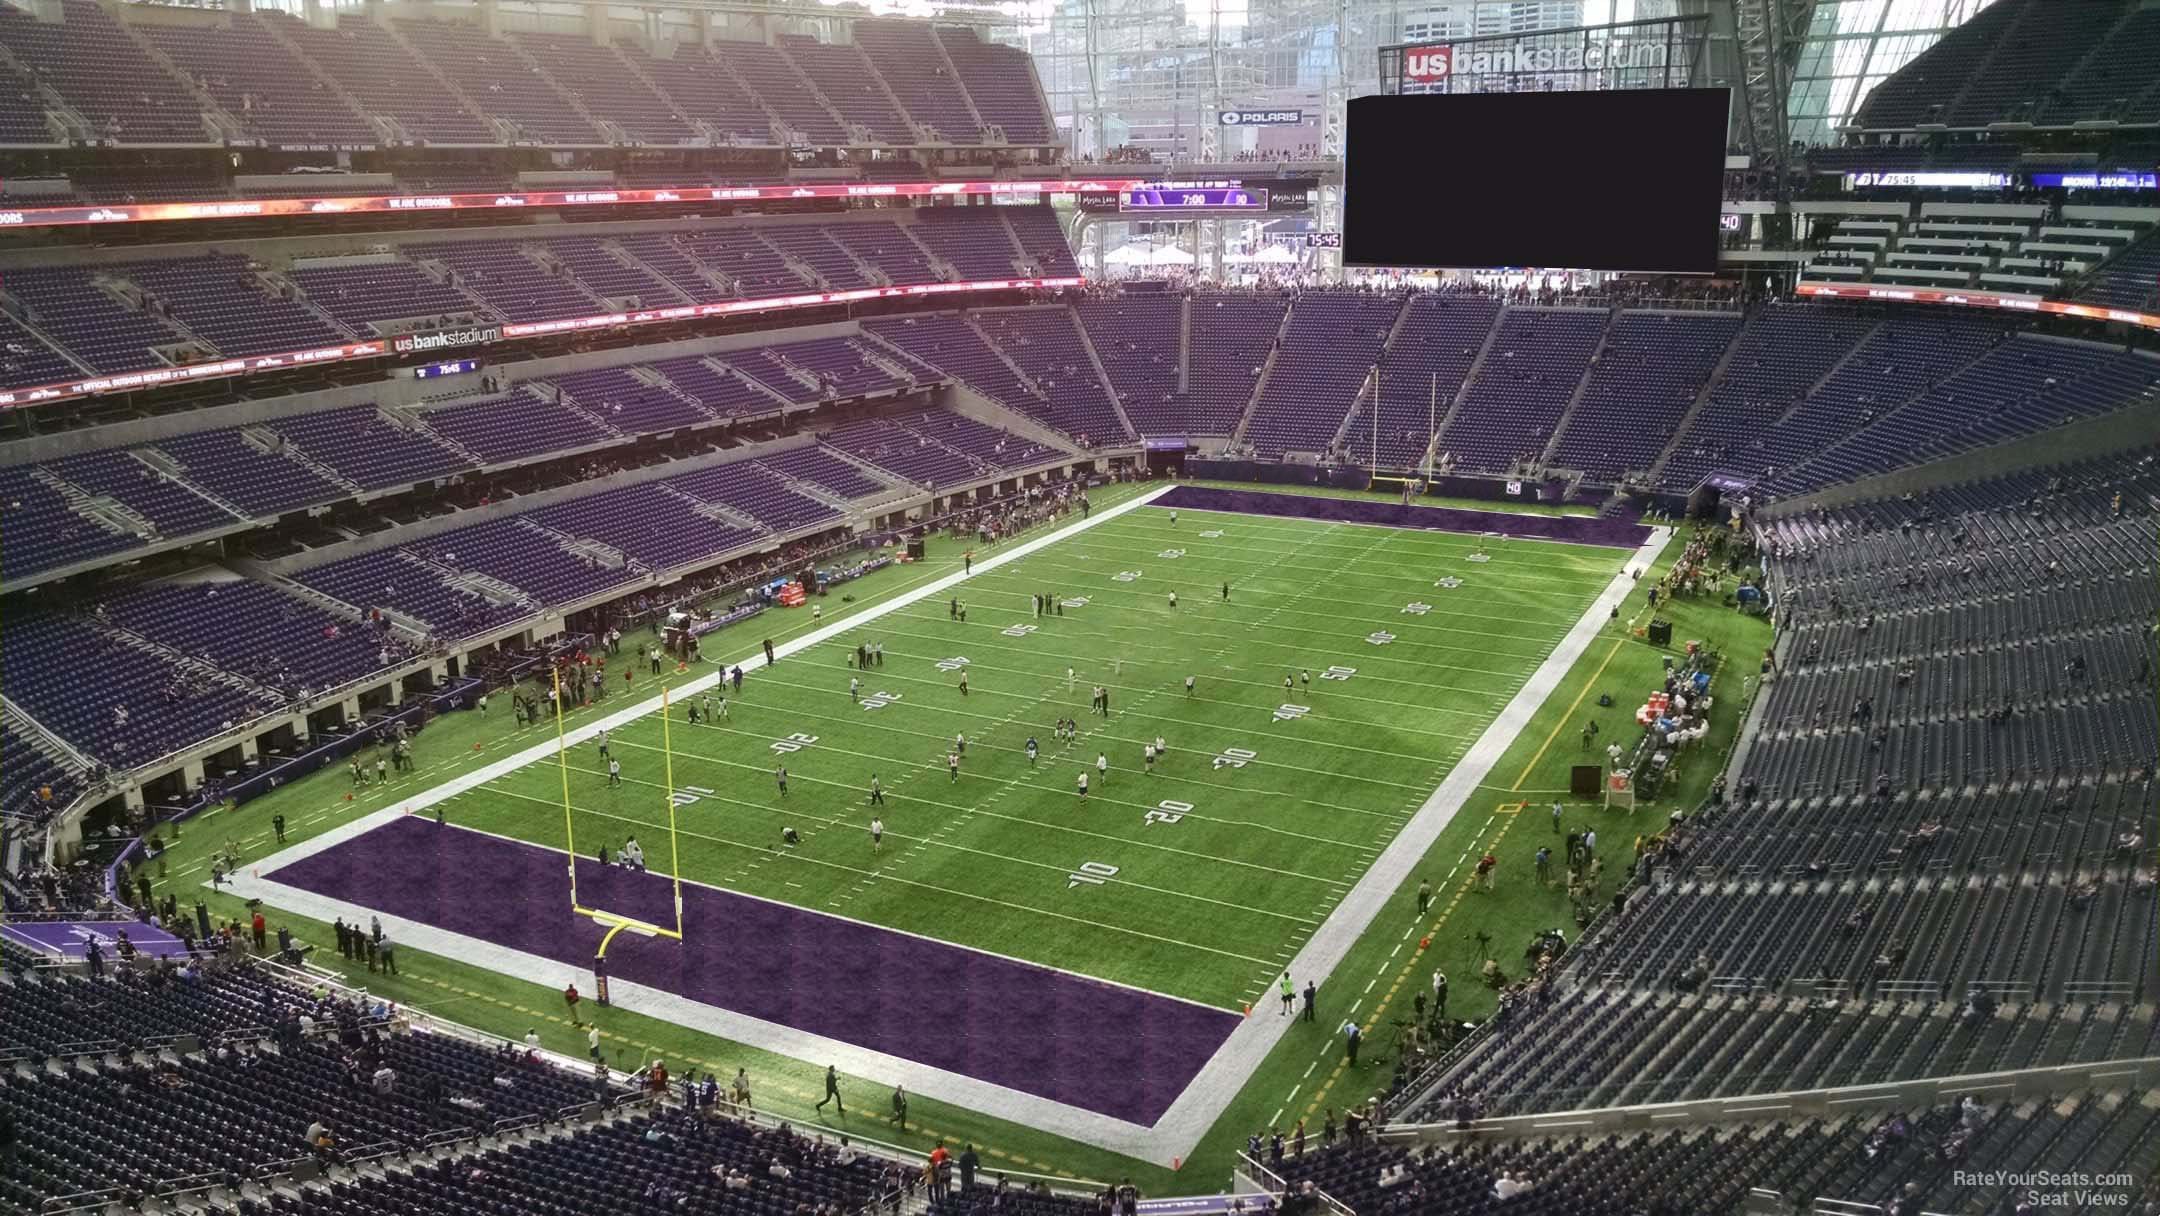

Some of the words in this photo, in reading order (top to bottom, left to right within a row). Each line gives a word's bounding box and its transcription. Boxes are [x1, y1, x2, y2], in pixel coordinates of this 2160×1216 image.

[1242, 112, 1299, 123] POLARIS
[1309, 233, 1340, 246] 75:45
[770, 732, 819, 752] 20
[1144, 800, 1195, 824] 20
[1068, 861, 1120, 885] 10
